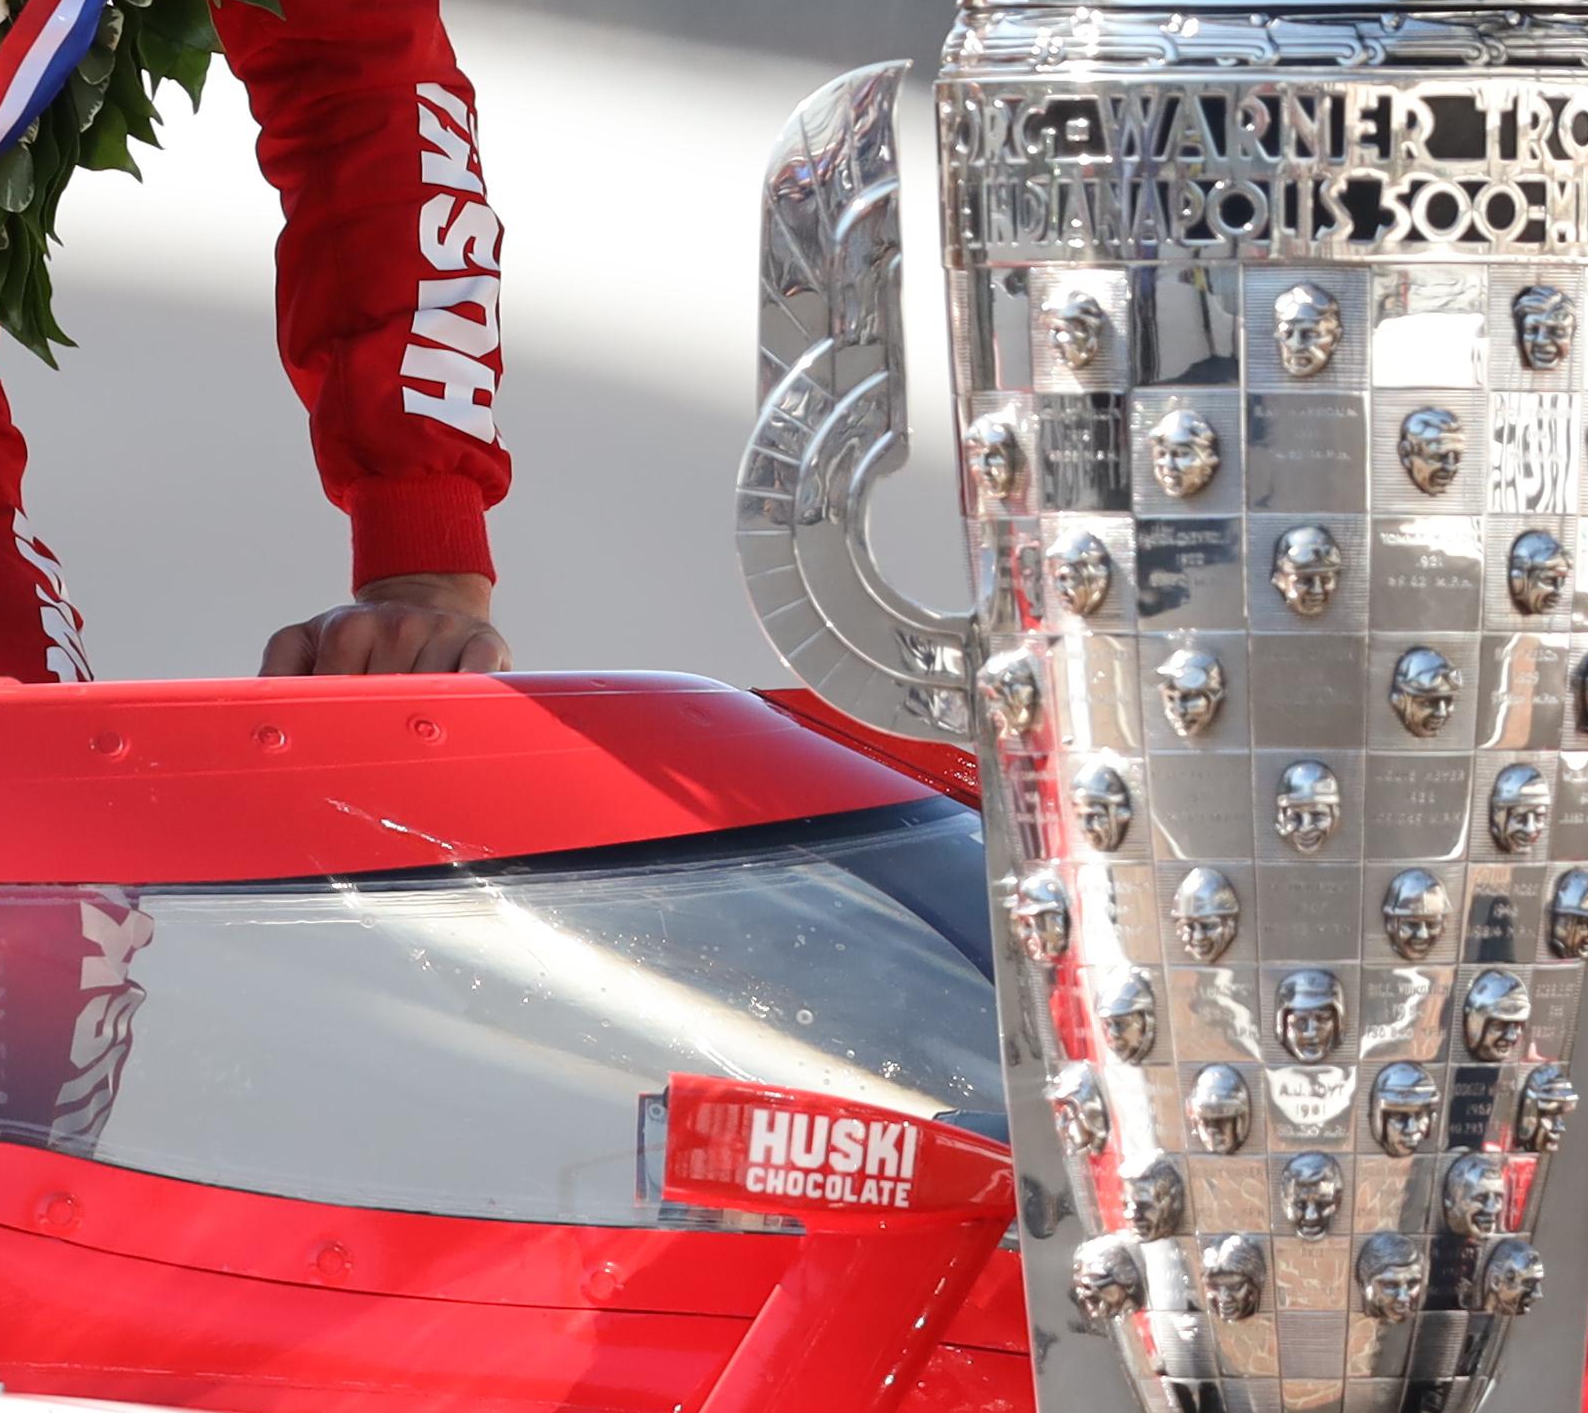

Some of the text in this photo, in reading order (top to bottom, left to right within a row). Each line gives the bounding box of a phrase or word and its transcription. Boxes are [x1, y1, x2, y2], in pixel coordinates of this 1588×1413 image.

[399, 82, 502, 445] HUSKI
[748, 1108, 918, 1179] HUSKI
[745, 1166, 912, 1208] CHOCOLATE
